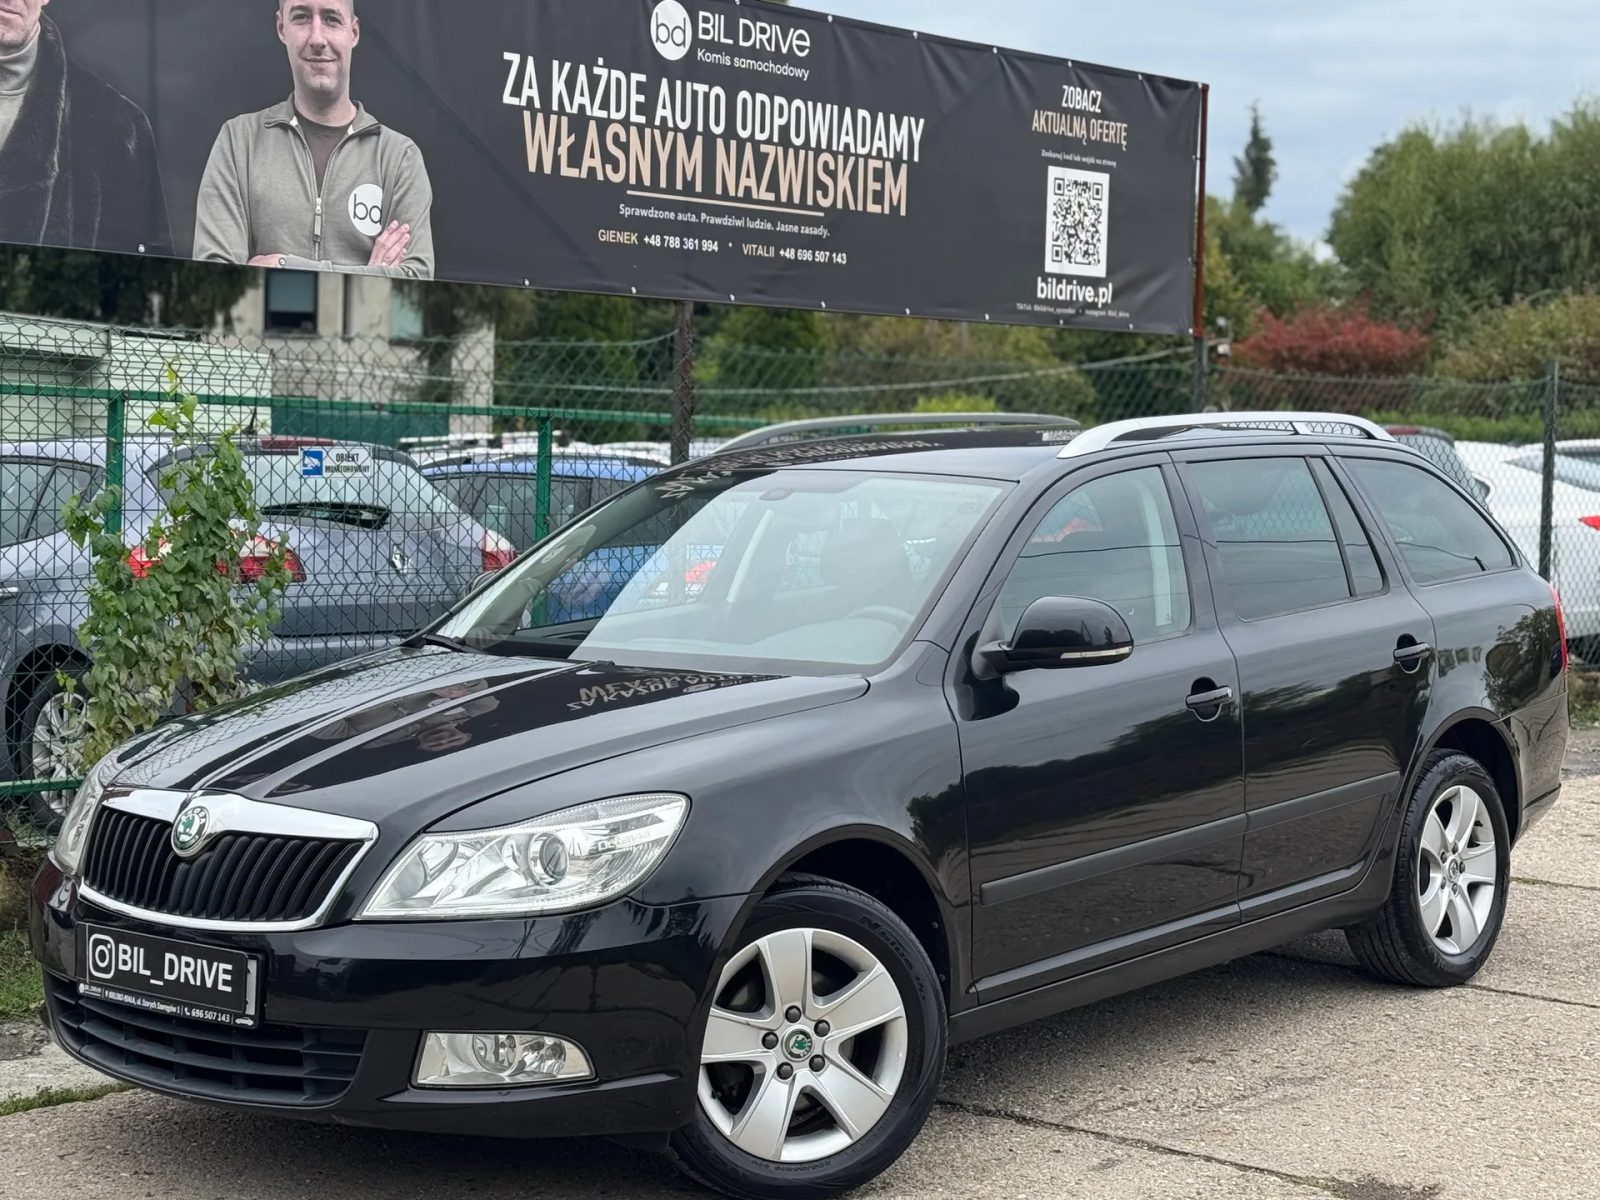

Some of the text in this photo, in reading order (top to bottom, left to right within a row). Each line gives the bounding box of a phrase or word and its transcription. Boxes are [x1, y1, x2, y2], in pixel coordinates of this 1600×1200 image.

[655, 12, 686, 48] bd
[698, 10, 734, 45] BIL
[697, 47, 810, 82] Komis samochodowy
[502, 51, 925, 163] ZA KAŻDE AUTO ODPOWIADAMY
[1061, 84, 1102, 113] ZOBACZ
[1032, 109, 1128, 151] AKTUALNĄ OFERTĘ
[523, 110, 908, 217] WŁASNYM NAZWISKIEM
[619, 203, 830, 239] Sprawdzone auta. Prawdziwi ludzie. Jasne zasady.
[598, 229, 719, 252] GIENEK +48 788 361 994
[742, 243, 847, 265] VITALII +48 696 507 143
[1036, 276, 1113, 308] bildrive.pl
[117, 943, 233, 993] BIL_DRIVE
[191, 1008, 204, 1018] 696
[204, 1009, 217, 1020] 507
[217, 1012, 230, 1023] 143
